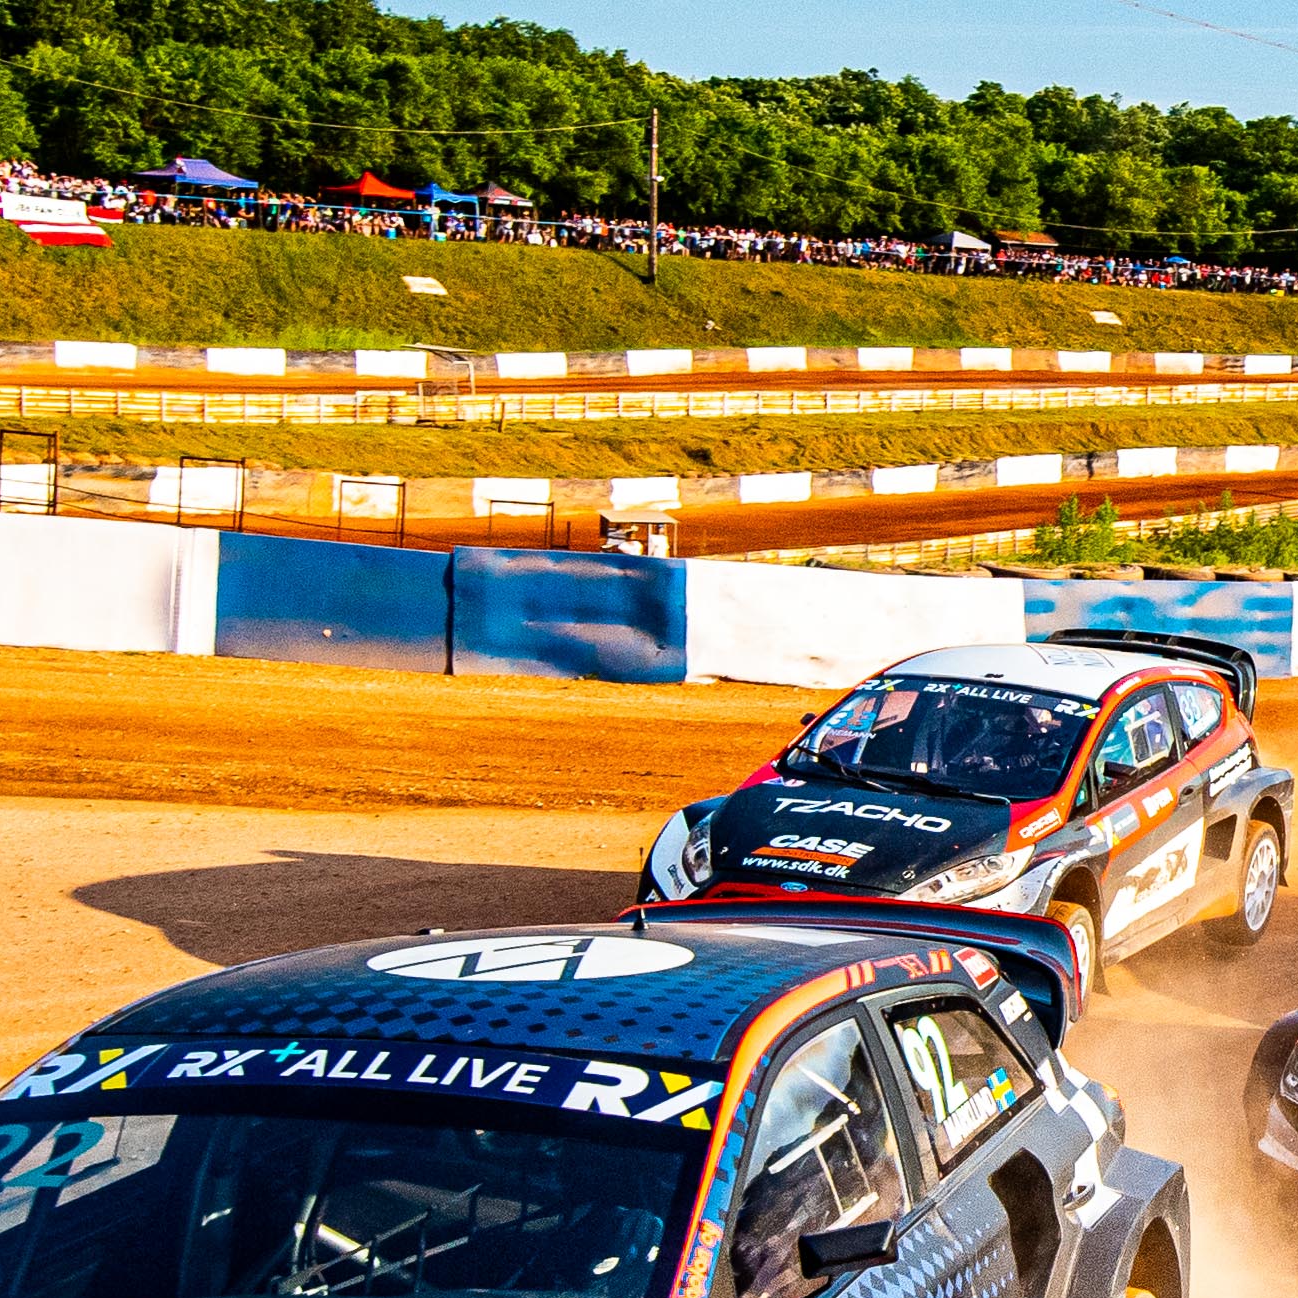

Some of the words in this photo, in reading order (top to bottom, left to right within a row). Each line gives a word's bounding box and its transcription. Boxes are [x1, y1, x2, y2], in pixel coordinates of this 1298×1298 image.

[855, 679, 904, 691] RX
[958, 686, 990, 698] ALL
[992, 688, 1033, 704] LIVE
[1054, 699, 1100, 719] RX
[773, 797, 952, 833] TZACHO
[768, 834, 876, 859] CASE
[741, 856, 852, 879] www.sdk.dk
[0, 1044, 168, 1101] RX
[291, 1048, 397, 1083] ALL
[408, 1054, 552, 1095] LIVE
[903, 1015, 969, 1124] 92
[562, 1060, 725, 1133] RX
